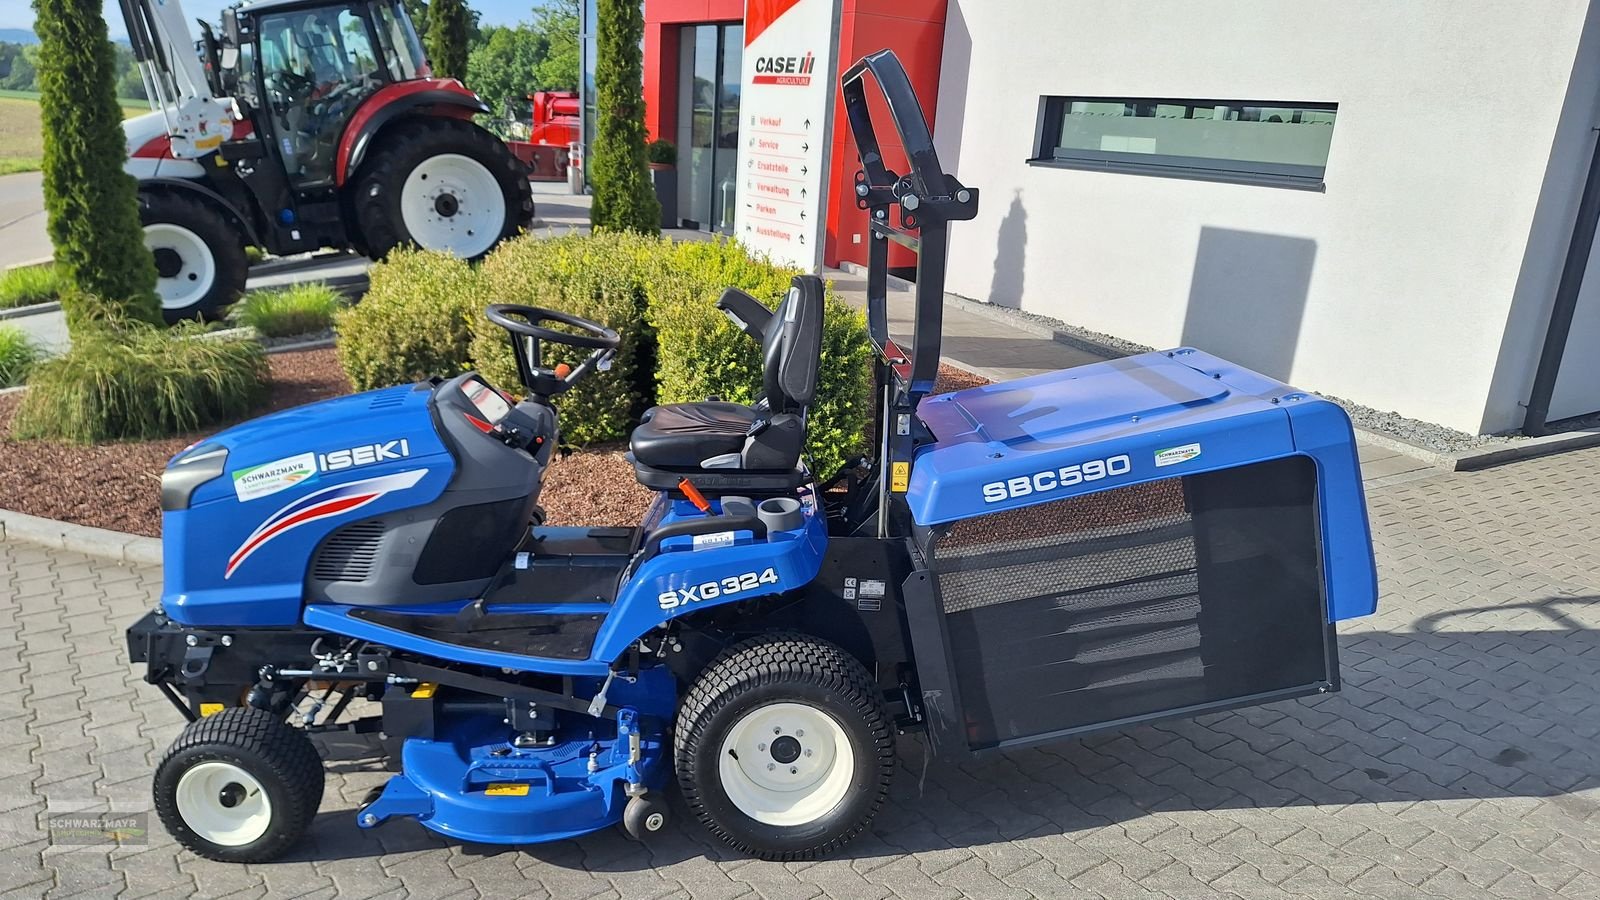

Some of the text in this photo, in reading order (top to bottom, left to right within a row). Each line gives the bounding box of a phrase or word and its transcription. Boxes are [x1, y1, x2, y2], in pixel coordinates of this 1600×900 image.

[755, 56, 797, 74] CASE
[776, 77, 809, 85] AGRICULTURE
[759, 117, 782, 127] Verkauf
[758, 139, 779, 150] Service
[757, 161, 789, 173] Ersatzteile
[756, 182, 790, 197] Verwaltung
[756, 203, 777, 215] Parken
[756, 226, 791, 242] Ausstellung
[318, 438, 410, 472] ISEKI
[1158, 448, 1195, 458] SCHWARZMAYR
[241, 463, 304, 484] SCHWARZMAYR
[982, 454, 1131, 503] SBC590
